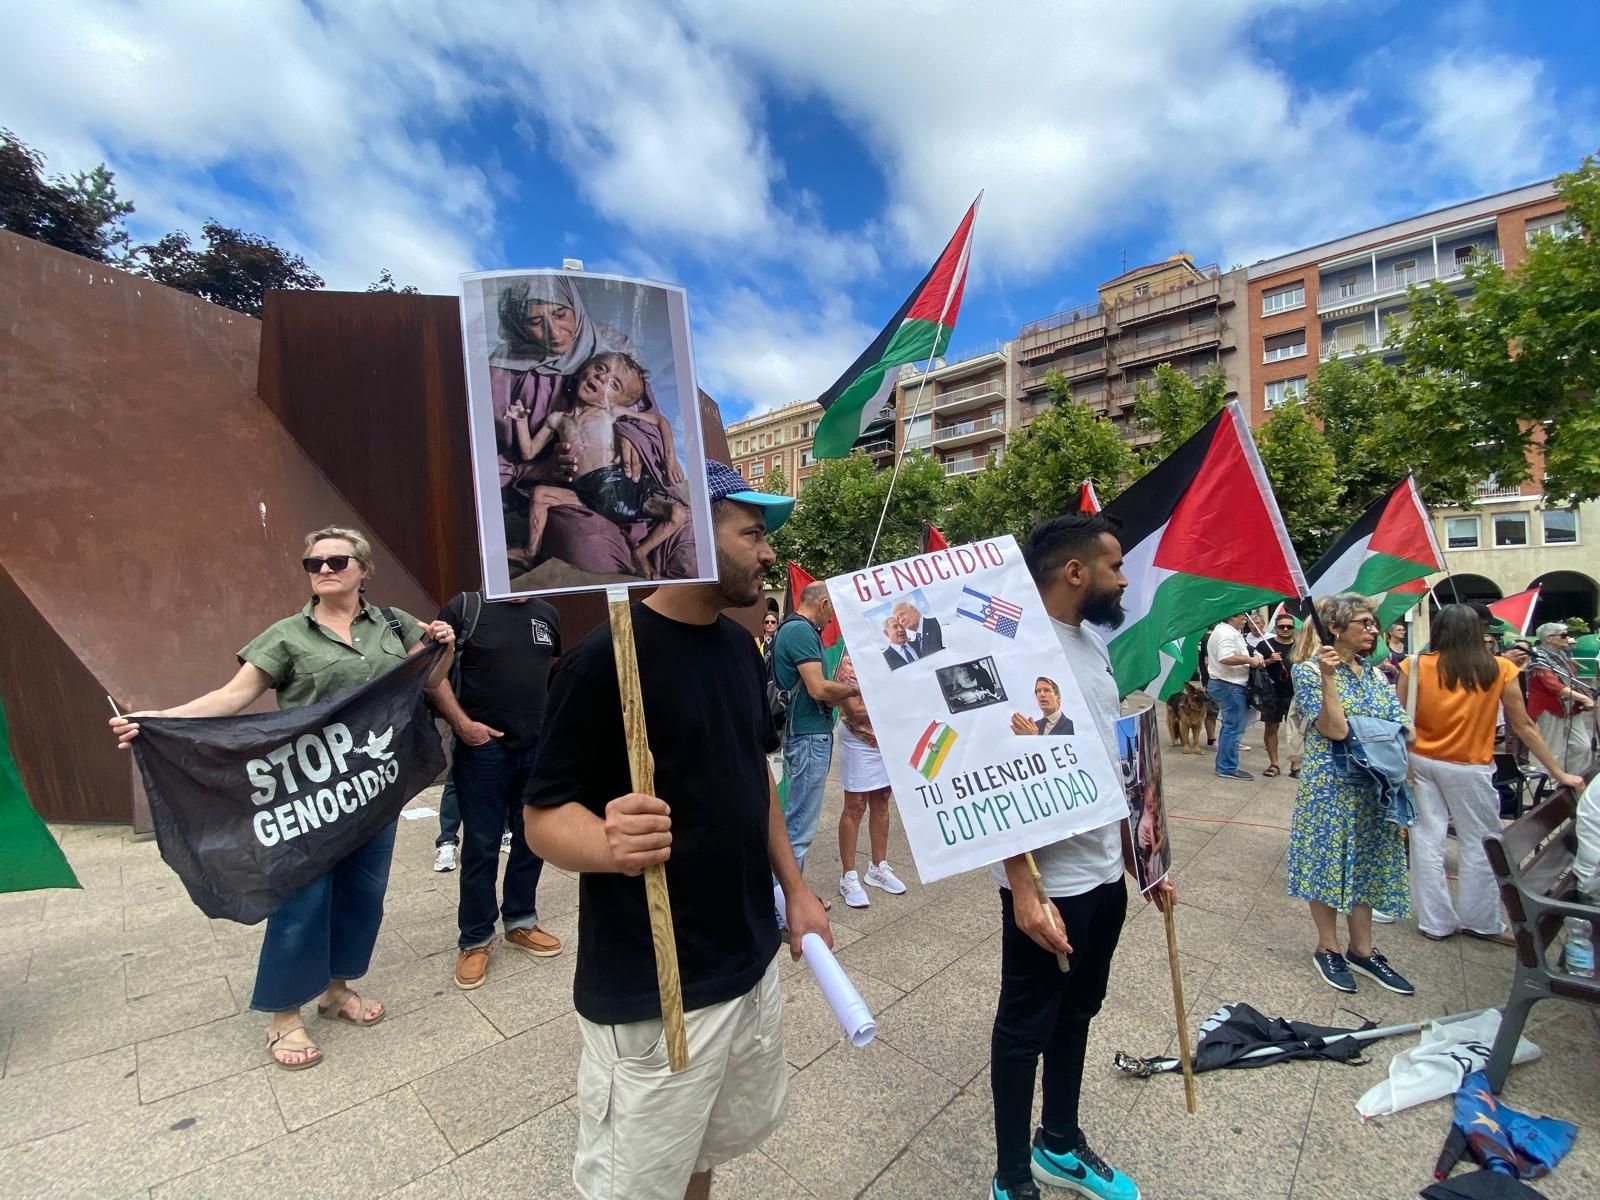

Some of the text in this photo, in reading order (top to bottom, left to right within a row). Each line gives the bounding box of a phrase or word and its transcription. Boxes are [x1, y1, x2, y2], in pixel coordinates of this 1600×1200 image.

[853, 542, 1004, 602] GENOCIDIO
[246, 723, 354, 806] STOP
[253, 759, 399, 847] GENOCIDIO
[915, 743, 1078, 808] TU SILENCIO ES
[936, 769, 1098, 846] COMPLICIDAD
